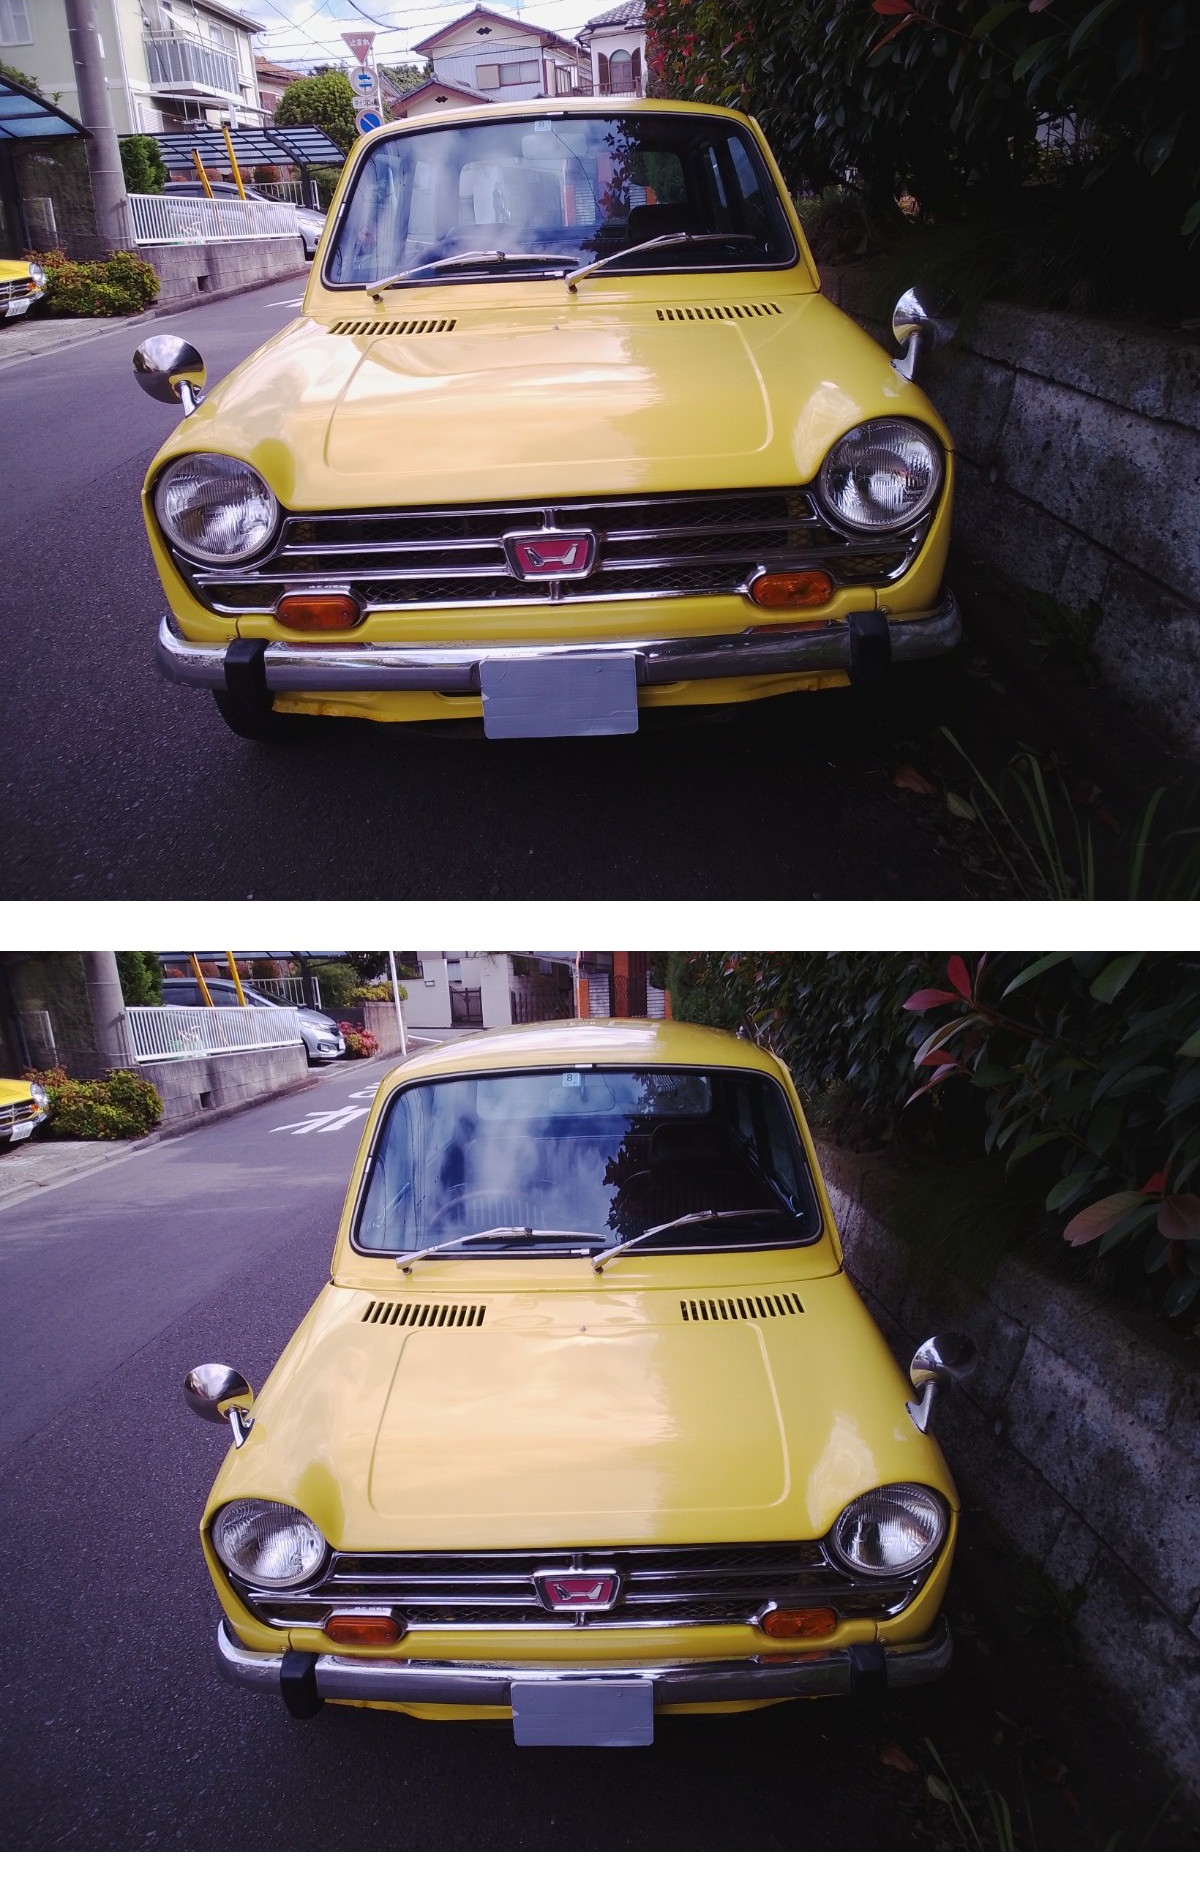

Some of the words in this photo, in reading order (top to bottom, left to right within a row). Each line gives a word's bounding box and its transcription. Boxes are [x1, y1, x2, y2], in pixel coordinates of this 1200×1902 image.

[349, 38, 370, 47] 止まれ
[566, 1073, 573, 1082] 8
